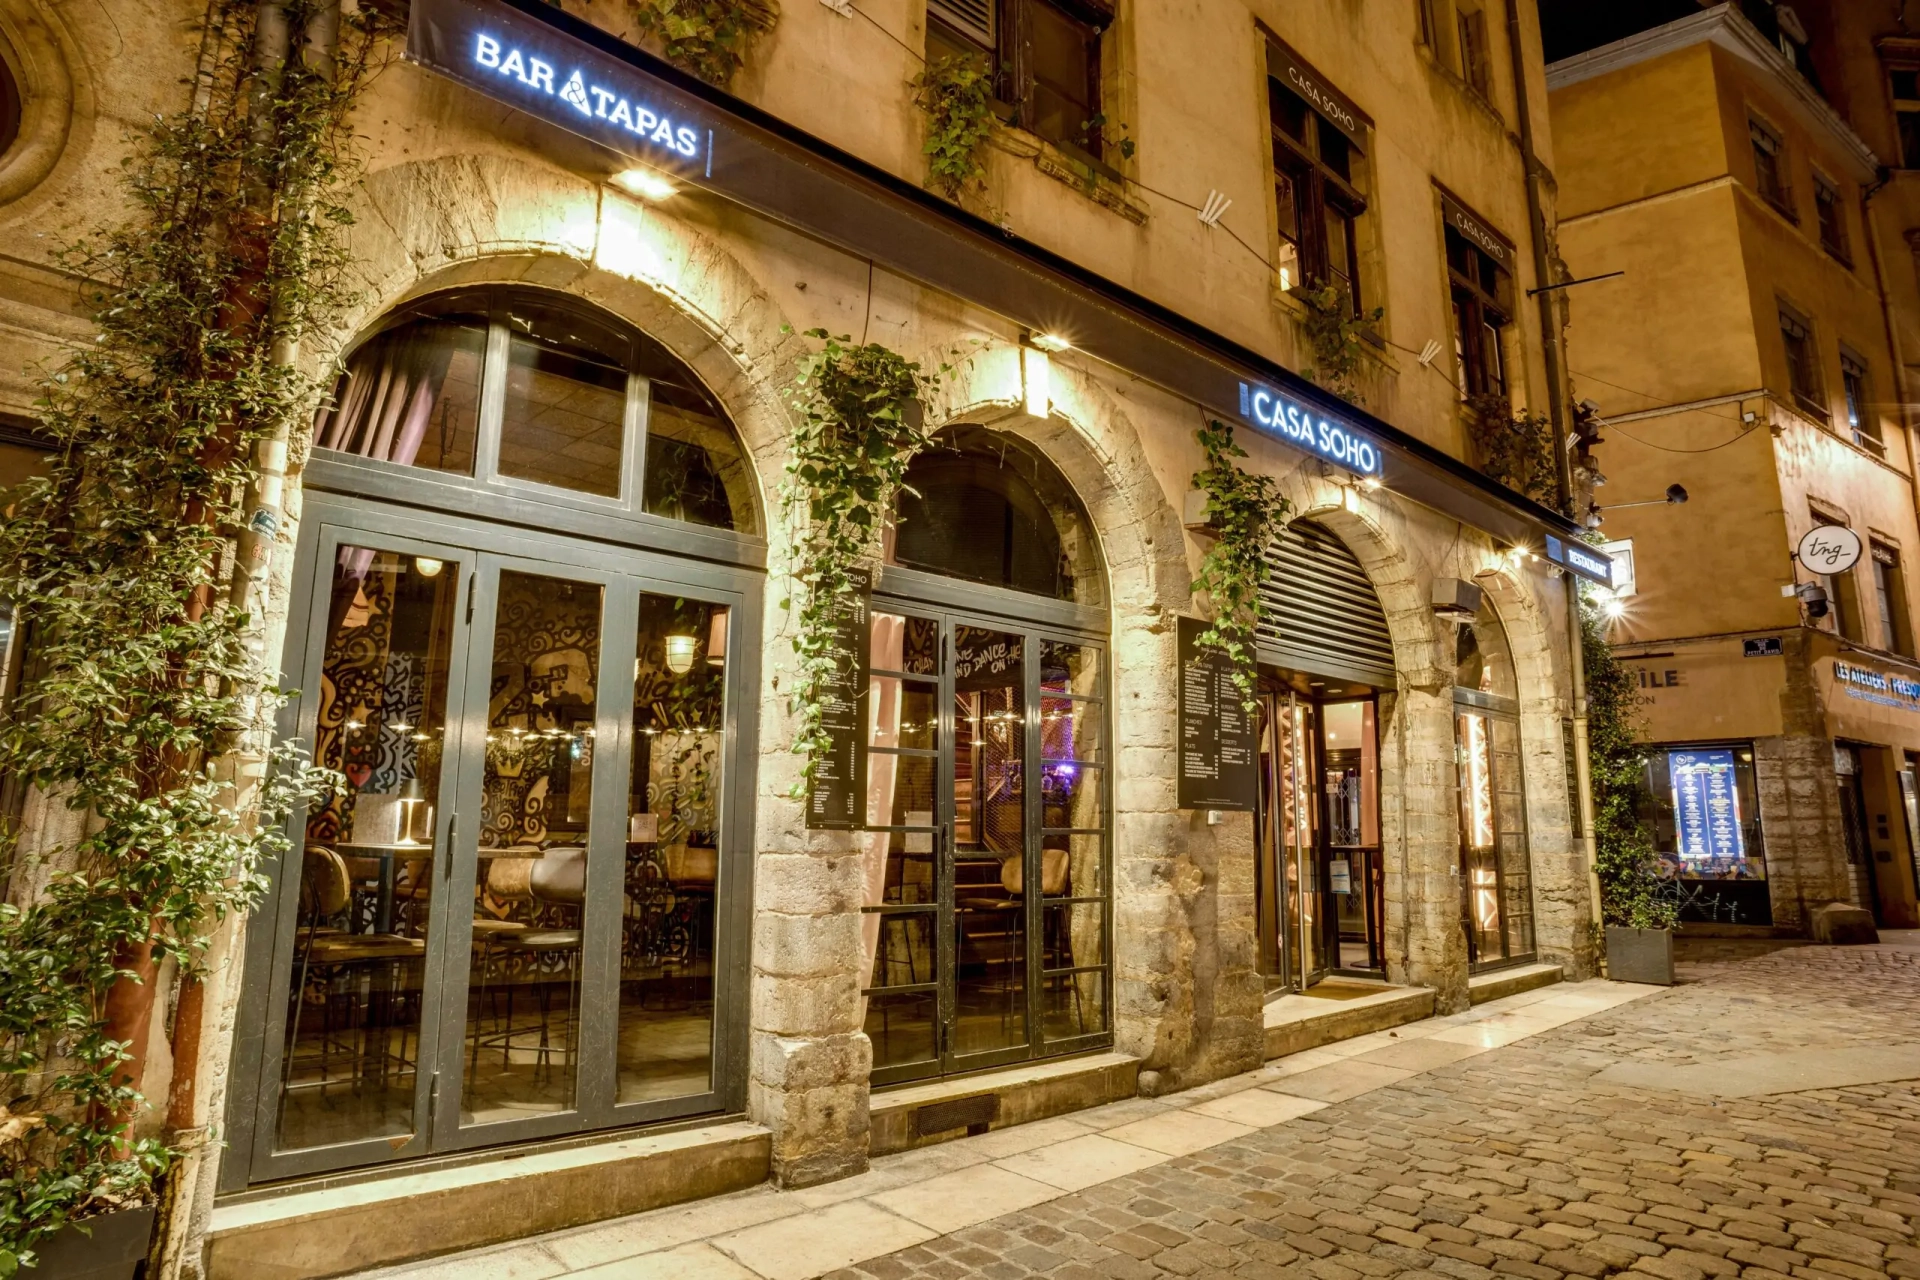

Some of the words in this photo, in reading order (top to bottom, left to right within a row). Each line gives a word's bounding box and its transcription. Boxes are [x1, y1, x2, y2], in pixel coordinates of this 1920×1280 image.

[475, 33, 555, 95] BAR
[591, 84, 698, 157] TAPAS
[1288, 66, 1322, 106] CASA
[1322, 95, 1355, 132] SOHO
[1456, 212, 1481, 241] CASA
[1480, 231, 1504, 259] SOHO
[1254, 392, 1316, 446] CASA
[1319, 421, 1376, 472] SOHO
[1568, 548, 1608, 578] RESTAURANT
[991, 659, 1006, 673] ON
[1850, 666, 1887, 690] ATELIERS
